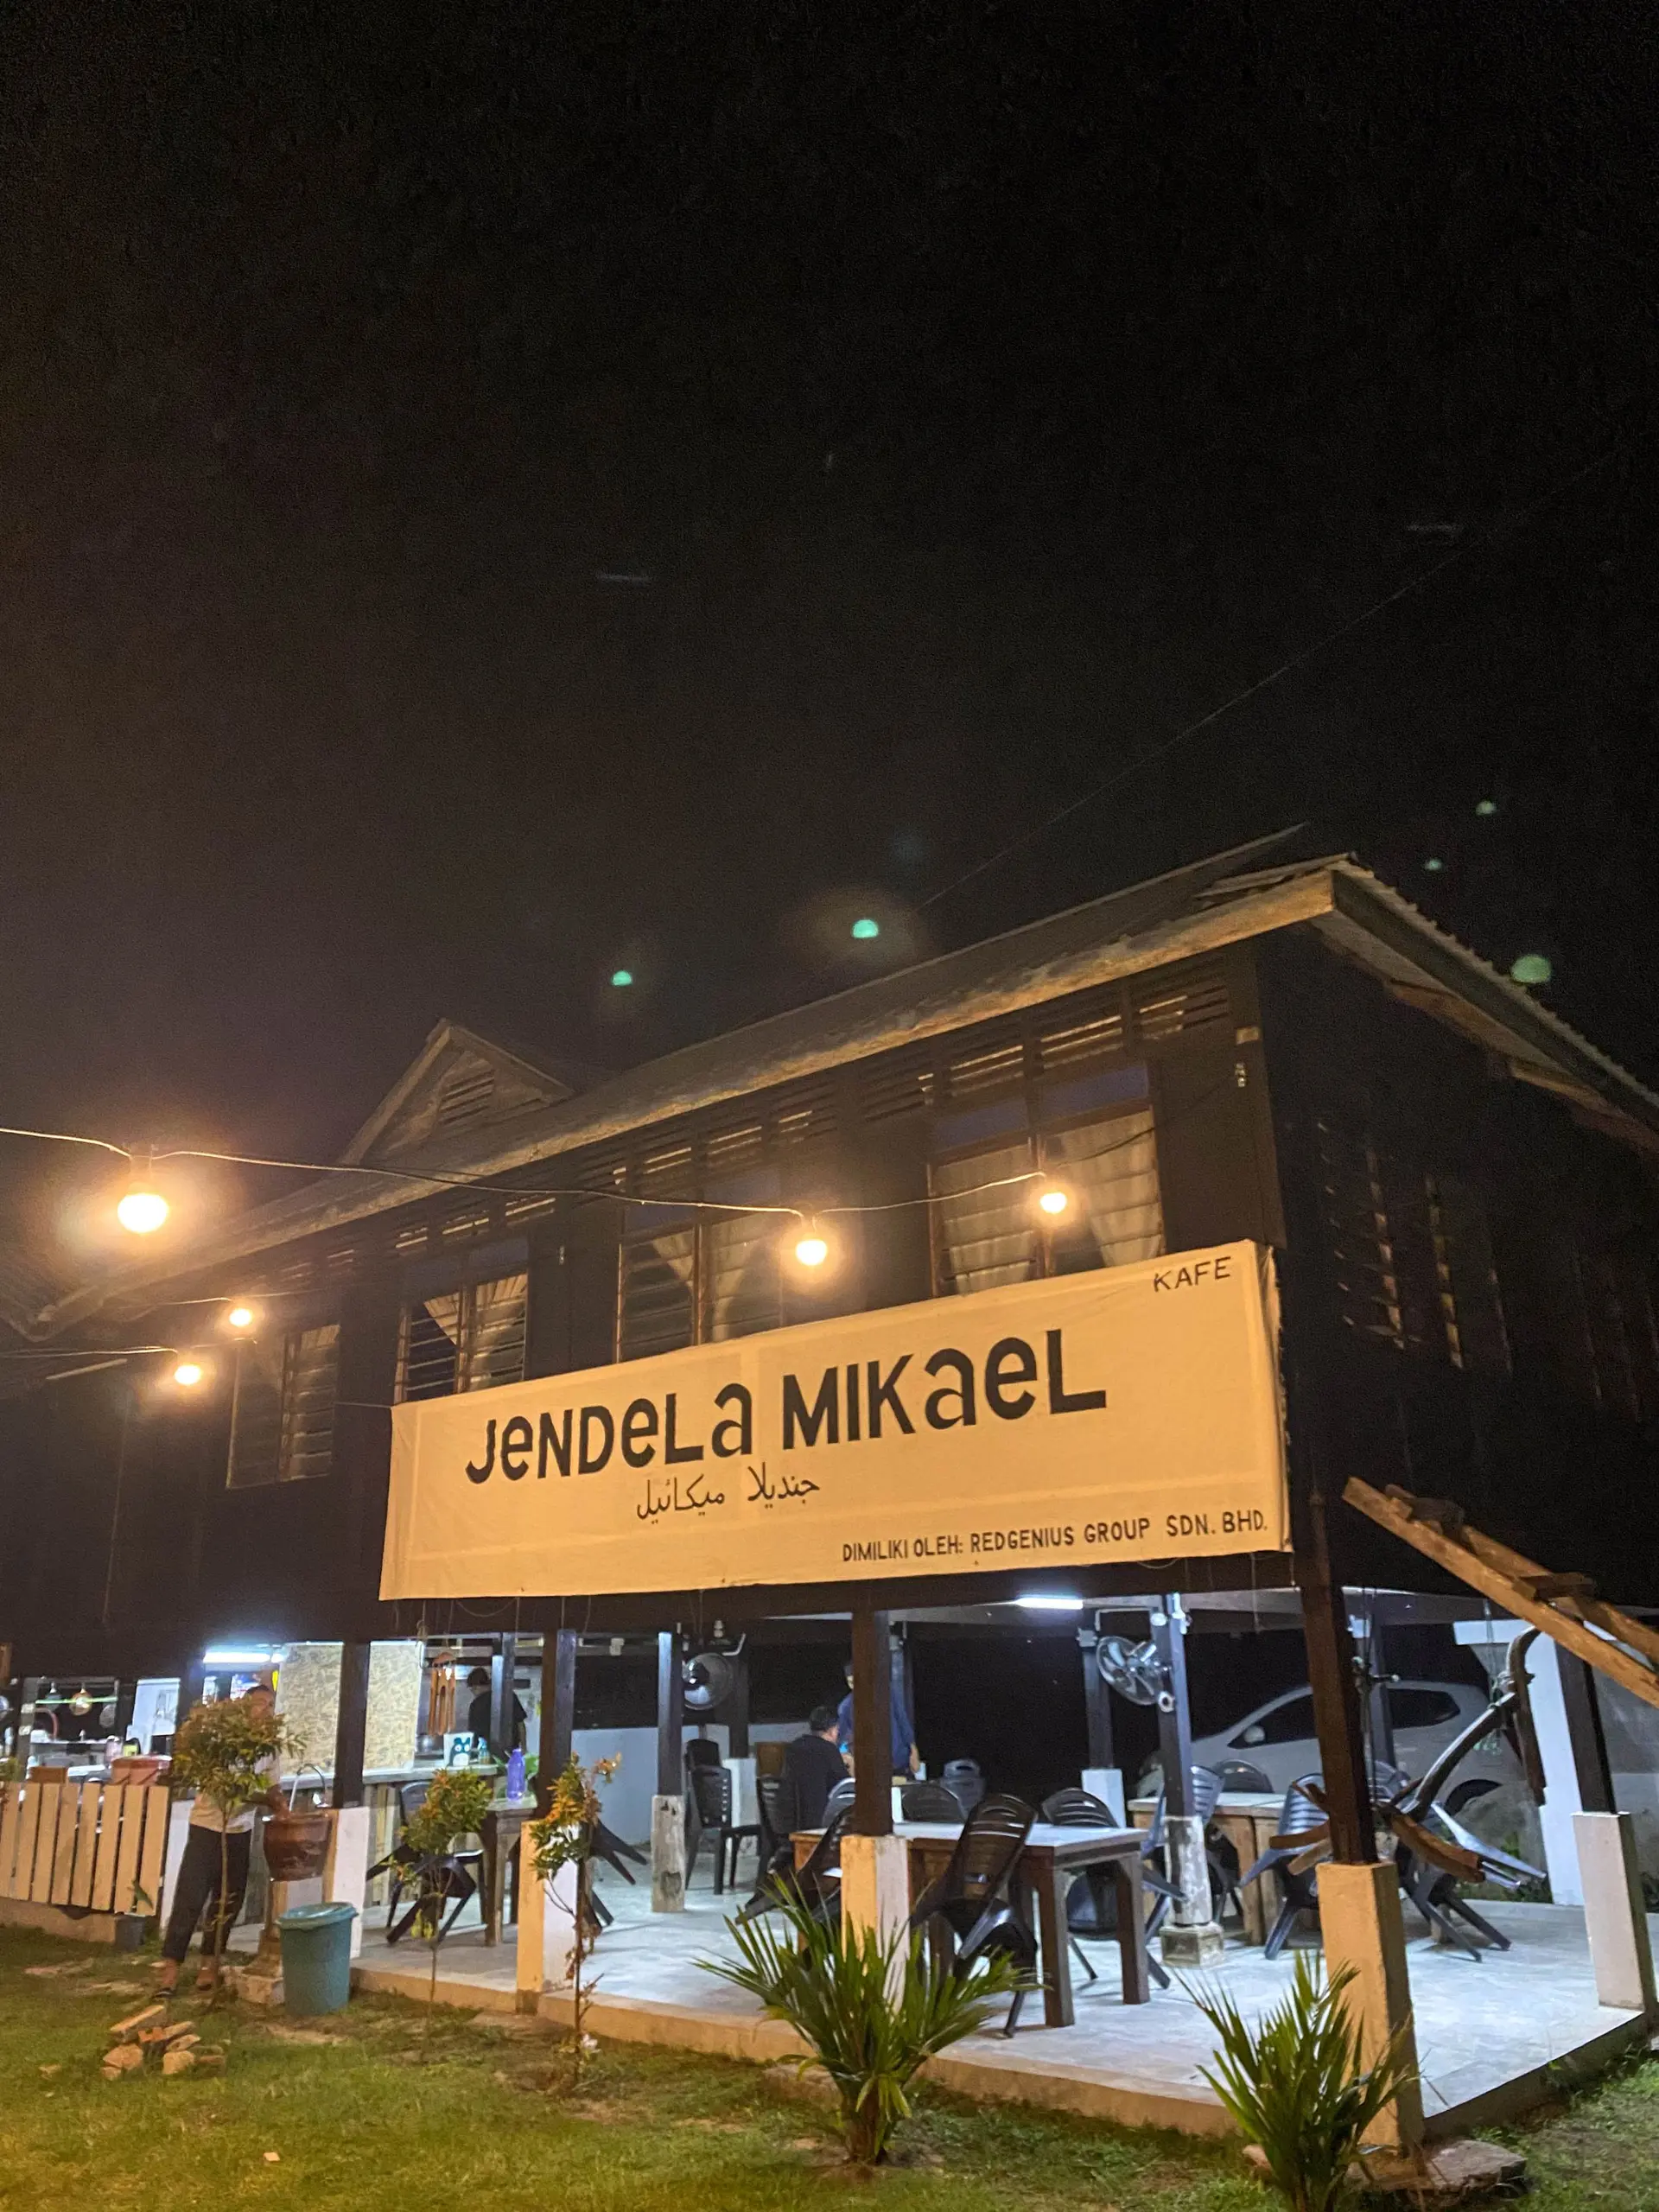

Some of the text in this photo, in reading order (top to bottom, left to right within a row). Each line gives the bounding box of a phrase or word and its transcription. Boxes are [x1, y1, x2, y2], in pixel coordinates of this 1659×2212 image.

[1154, 1256, 1231, 1293] KAFE
[637, 1462, 820, 1524] جنديلا ميكائيل
[842, 1510, 1268, 1561] DIMILIKI OLEH: REDGENIUS GROUP SDN. BHD.
